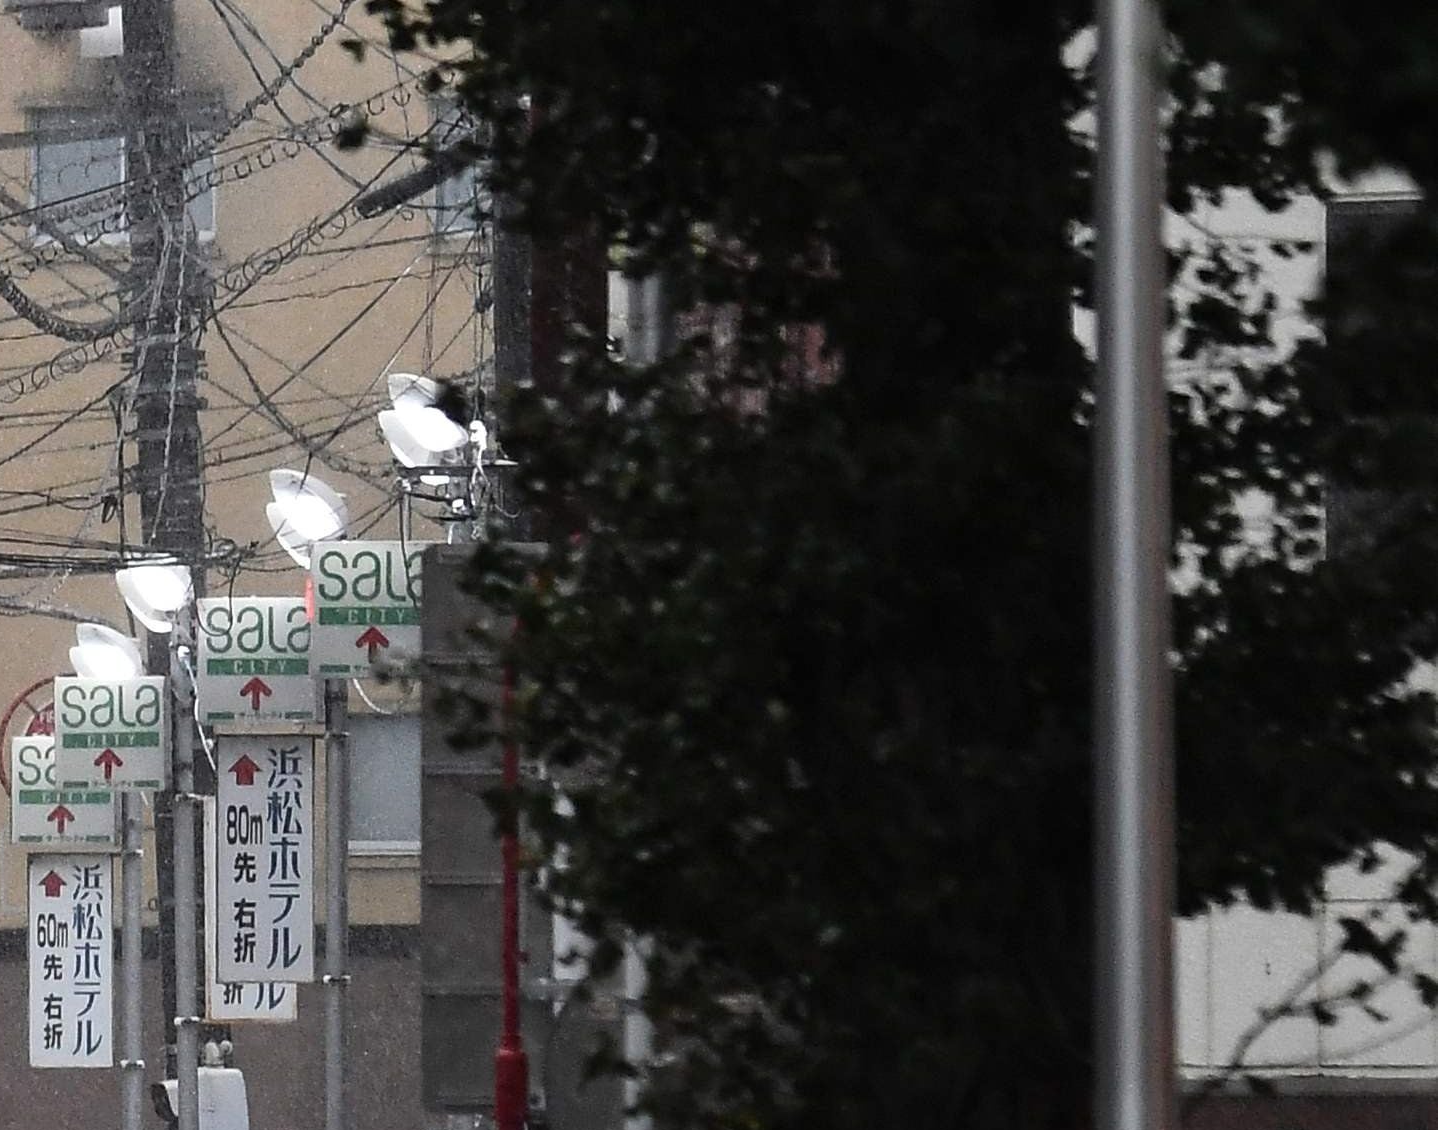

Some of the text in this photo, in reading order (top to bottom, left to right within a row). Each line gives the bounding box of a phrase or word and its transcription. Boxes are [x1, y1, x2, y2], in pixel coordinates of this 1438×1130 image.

[205, 605, 312, 654] sala
[347, 608, 408, 624] CITY
[232, 659, 288, 674] CITY
[61, 684, 161, 728] sala
[86, 734, 136, 747] CITY
[266, 746, 303, 970] 浜松ホテル
[72, 864, 104, 1057] 浜松ホテル
